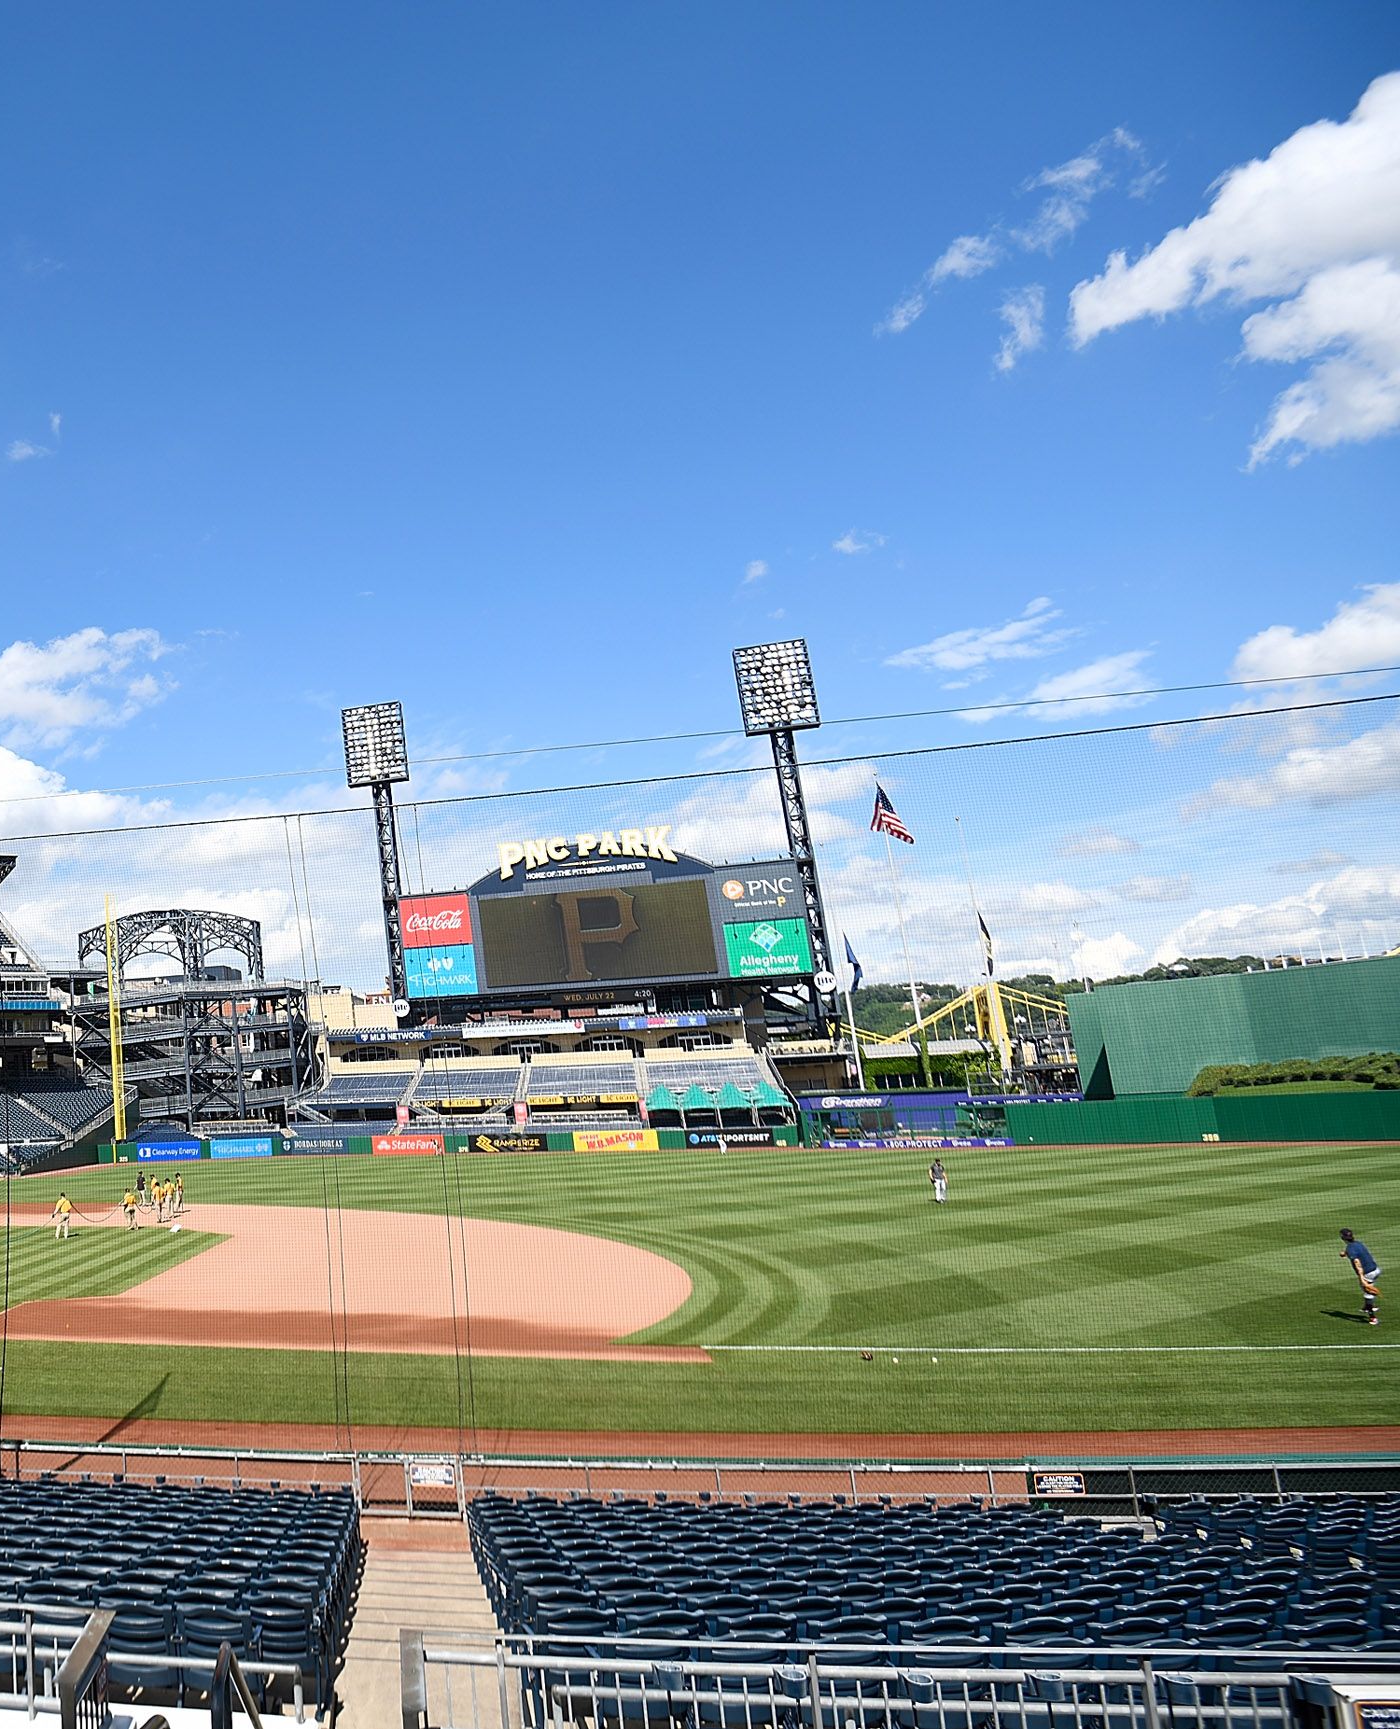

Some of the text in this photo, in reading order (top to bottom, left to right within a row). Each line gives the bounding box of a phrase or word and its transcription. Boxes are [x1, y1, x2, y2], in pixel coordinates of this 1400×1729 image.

[497, 825, 678, 880] PNC PARK
[526, 871, 546, 880] HOME
[572, 865, 616, 875] PITTSBURGH
[616, 862, 646, 871] PIRATES
[745, 877, 794, 896] PNC
[740, 953, 799, 967] Allegheny
[634, 989, 651, 998] 4:20
[370, 1031, 425, 1042] MLB NETWORK
[700, 1134, 721, 1142] AT&T
[152, 1147, 199, 1157] Clearway Energy
